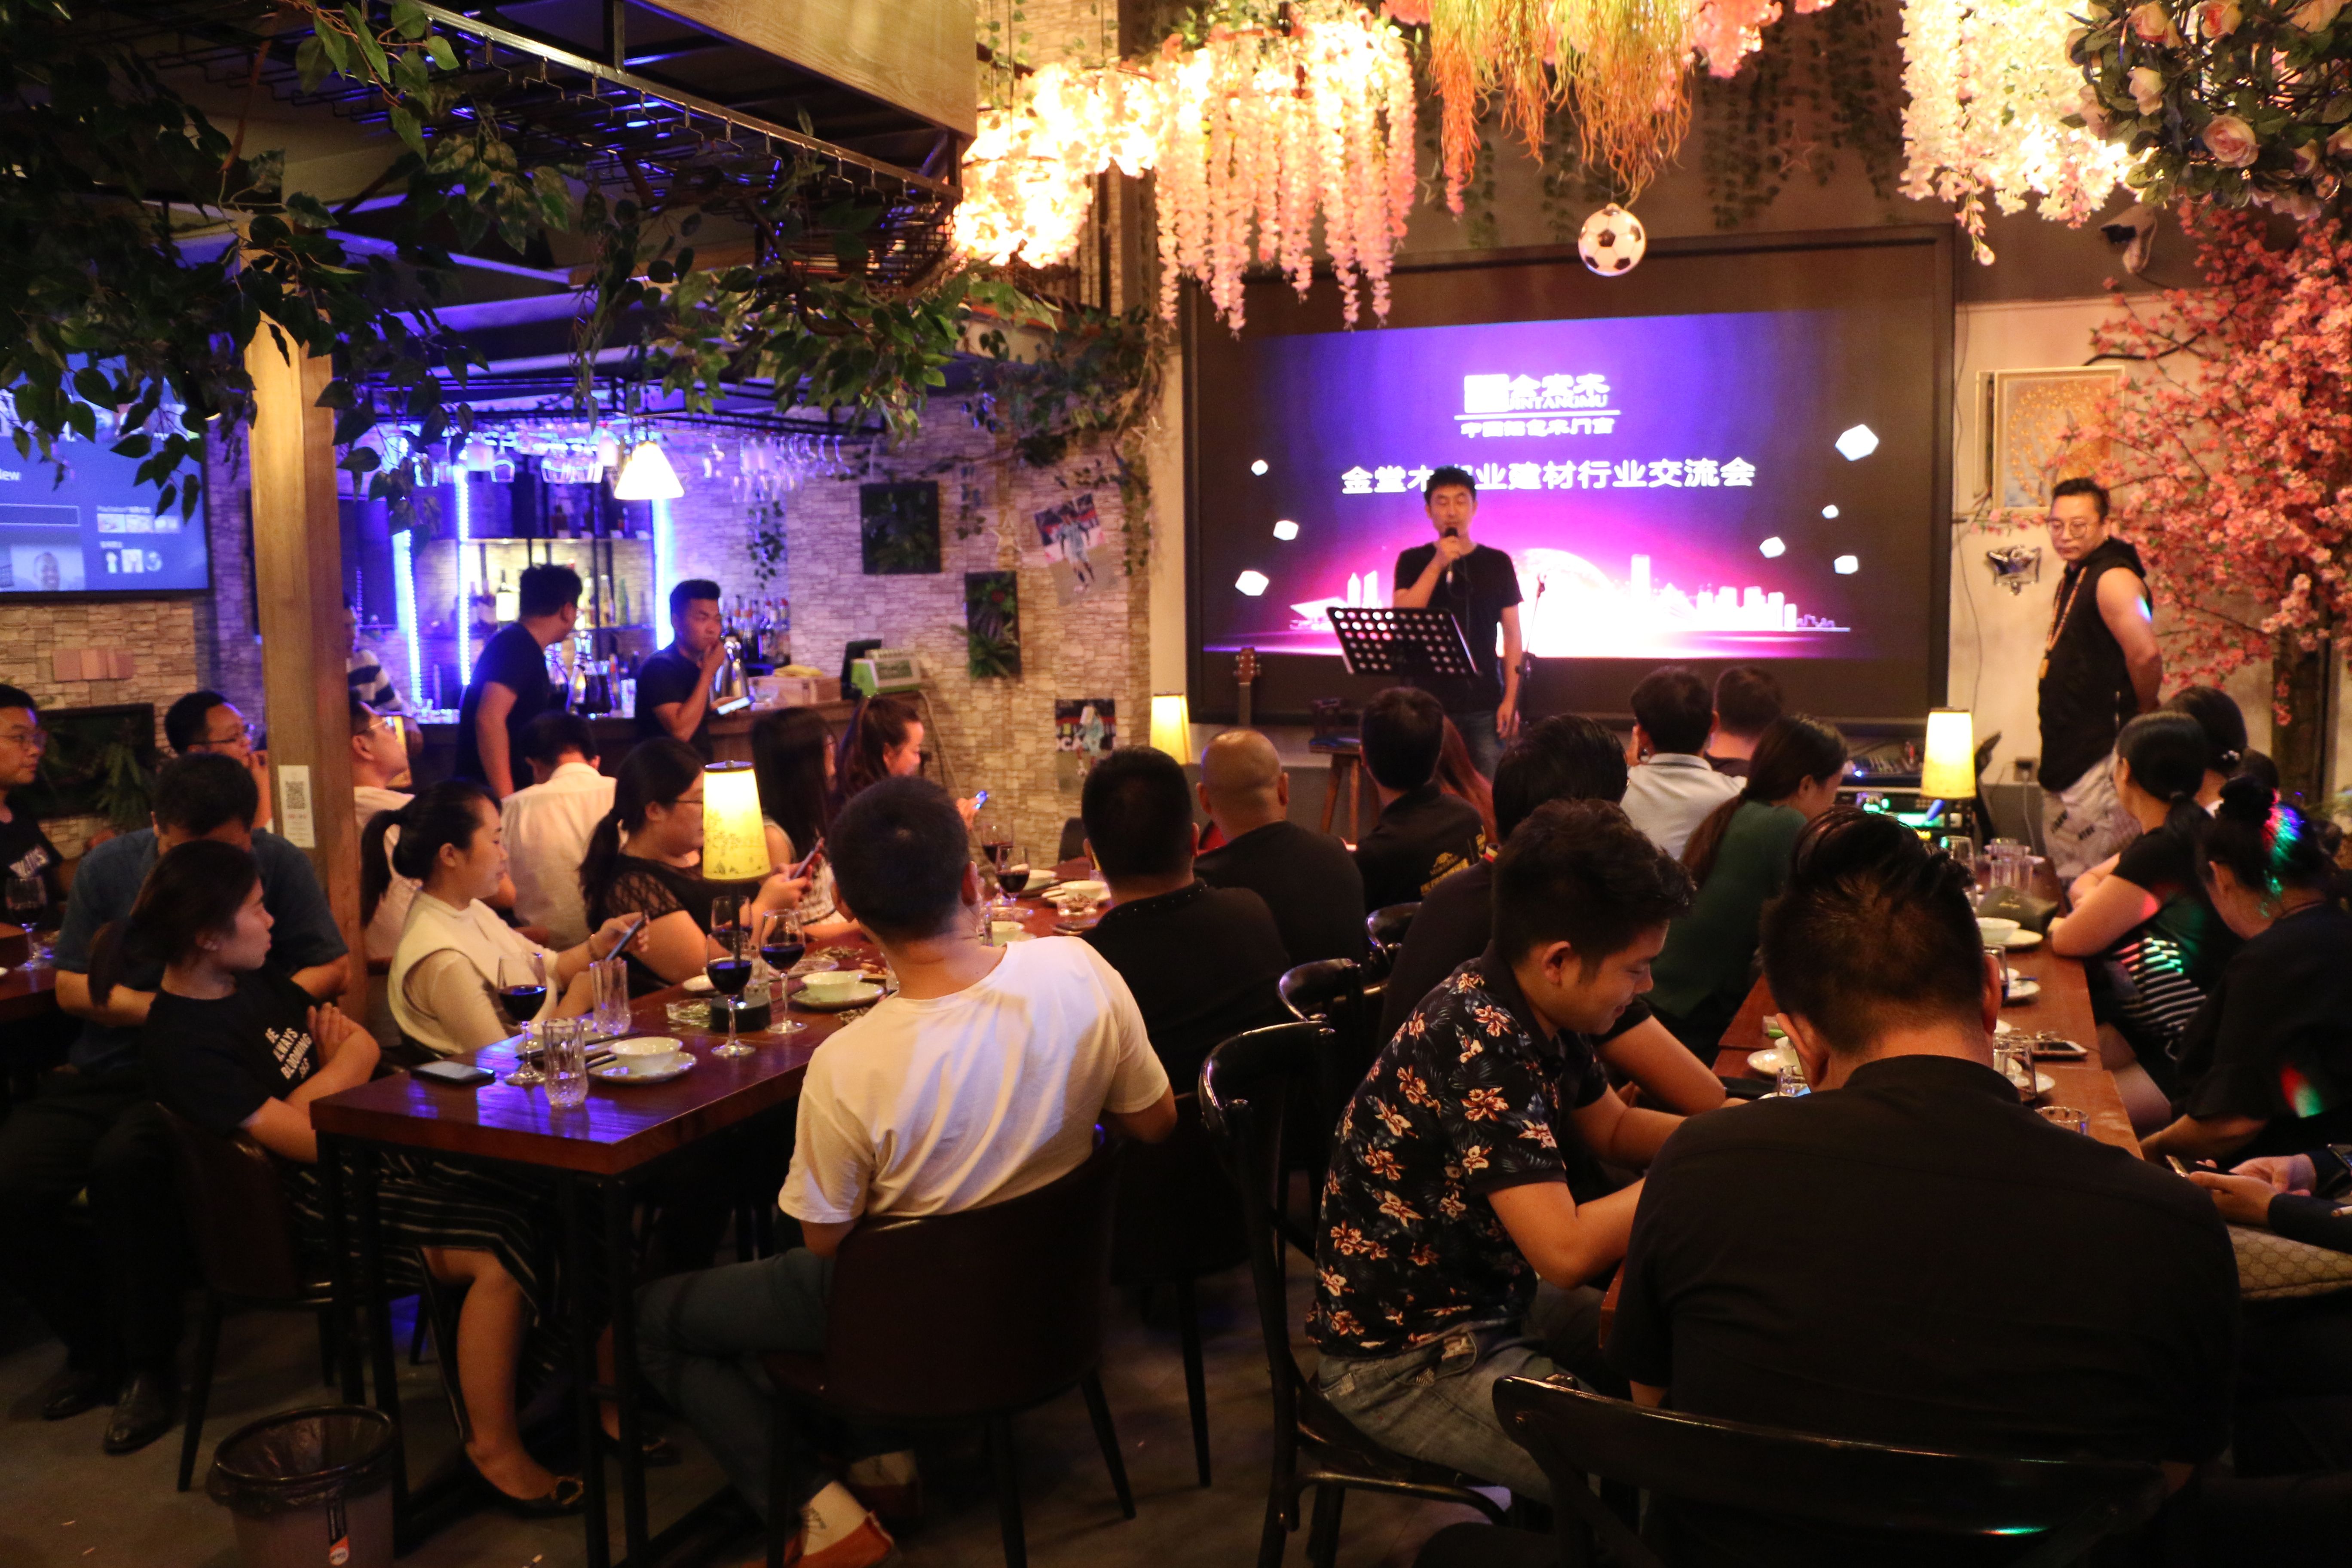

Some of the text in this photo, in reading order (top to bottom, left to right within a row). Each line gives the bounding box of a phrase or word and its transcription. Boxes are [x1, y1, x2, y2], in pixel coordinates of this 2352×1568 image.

[1341, 456, 1756, 494] 金堂木业建材行业交流会
